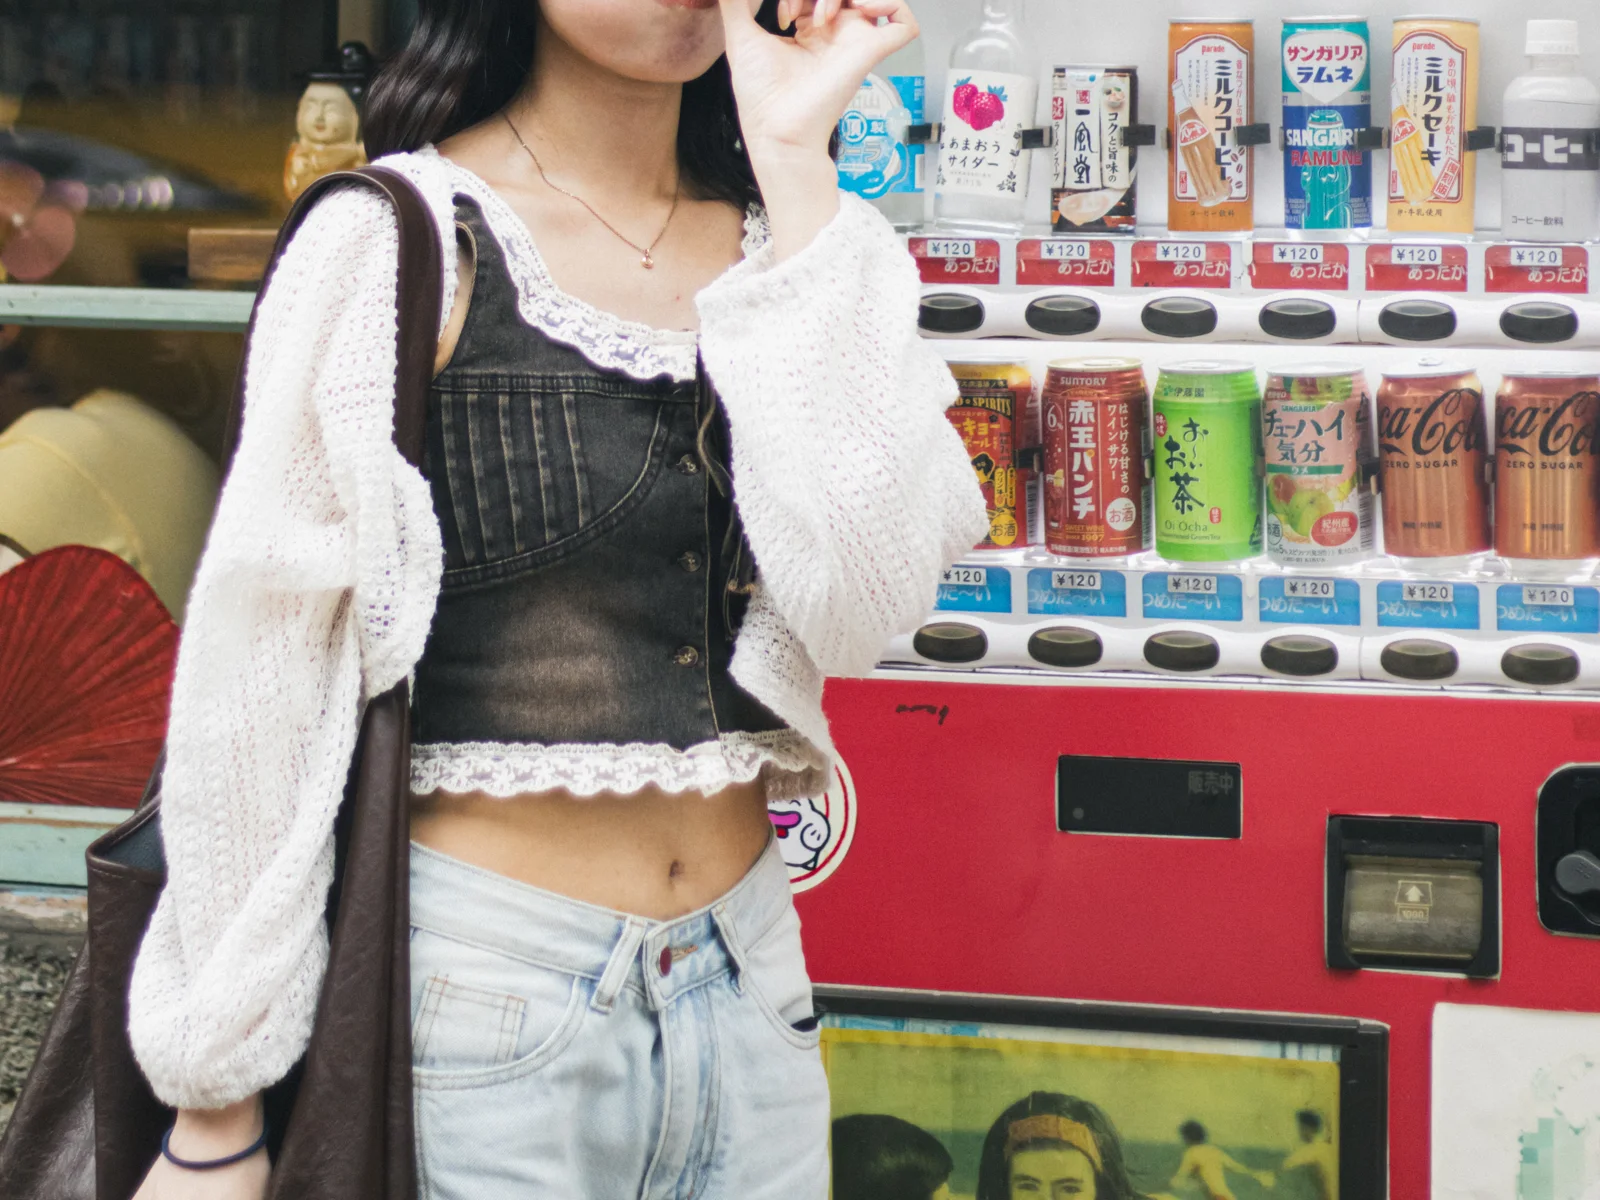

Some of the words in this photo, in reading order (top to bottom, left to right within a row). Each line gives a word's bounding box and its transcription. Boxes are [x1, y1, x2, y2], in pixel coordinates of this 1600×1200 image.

[1288, 46, 1362, 61] サンガリア
[1297, 66, 1353, 83] ラムネ
[1421, 57, 1445, 167] ミルクセーキ
[1214, 59, 1234, 181] ミルクコーヒー
[949, 136, 1001, 154] あまおう
[1074, 108, 1093, 184] 一風堂
[1106, 112, 1119, 182] コクと旨味の
[1508, 134, 1584, 163] コーヒー
[948, 155, 999, 169] サイダー
[1291, 150, 1362, 166] RAMUNE
[1512, 216, 1564, 226] コーヒー飲料
[932, 242, 971, 254] ¥120
[1046, 244, 1085, 256] ¥120
[1161, 246, 1201, 258] ¥120
[1278, 248, 1319, 260] ¥120
[1397, 249, 1437, 261] ¥120
[1516, 250, 1558, 263] ¥120
[1060, 377, 1107, 385] SUNTORY
[1174, 387, 1205, 397] 伊藤園
[973, 397, 1011, 416] SPIRITS
[1264, 409, 1345, 440] チューハイ
[1107, 404, 1119, 480] ワインサワー
[1119, 403, 1130, 493] はじける甘さの
[1277, 439, 1325, 463] 気分
[1069, 400, 1096, 519] 赤玉パンチ
[1385, 460, 1410, 468] ZERO
[1415, 459, 1458, 468] SUGAR
[1506, 461, 1535, 469] ZERO
[1540, 461, 1583, 469] SUGAR
[1164, 435, 1205, 515] お茶
[1109, 507, 1133, 523] お酒
[1165, 520, 1175, 530] Oi
[1178, 520, 1208, 532] Ocha
[1322, 517, 1349, 528] 紀州産
[991, 522, 1016, 537] お酒
[1082, 533, 1104, 542] 1907
[943, 570, 982, 583] ¥120
[1057, 574, 1096, 587] ¥120
[1172, 577, 1212, 590] ¥120
[1289, 581, 1329, 594] ¥120
[1407, 586, 1448, 599] ¥120
